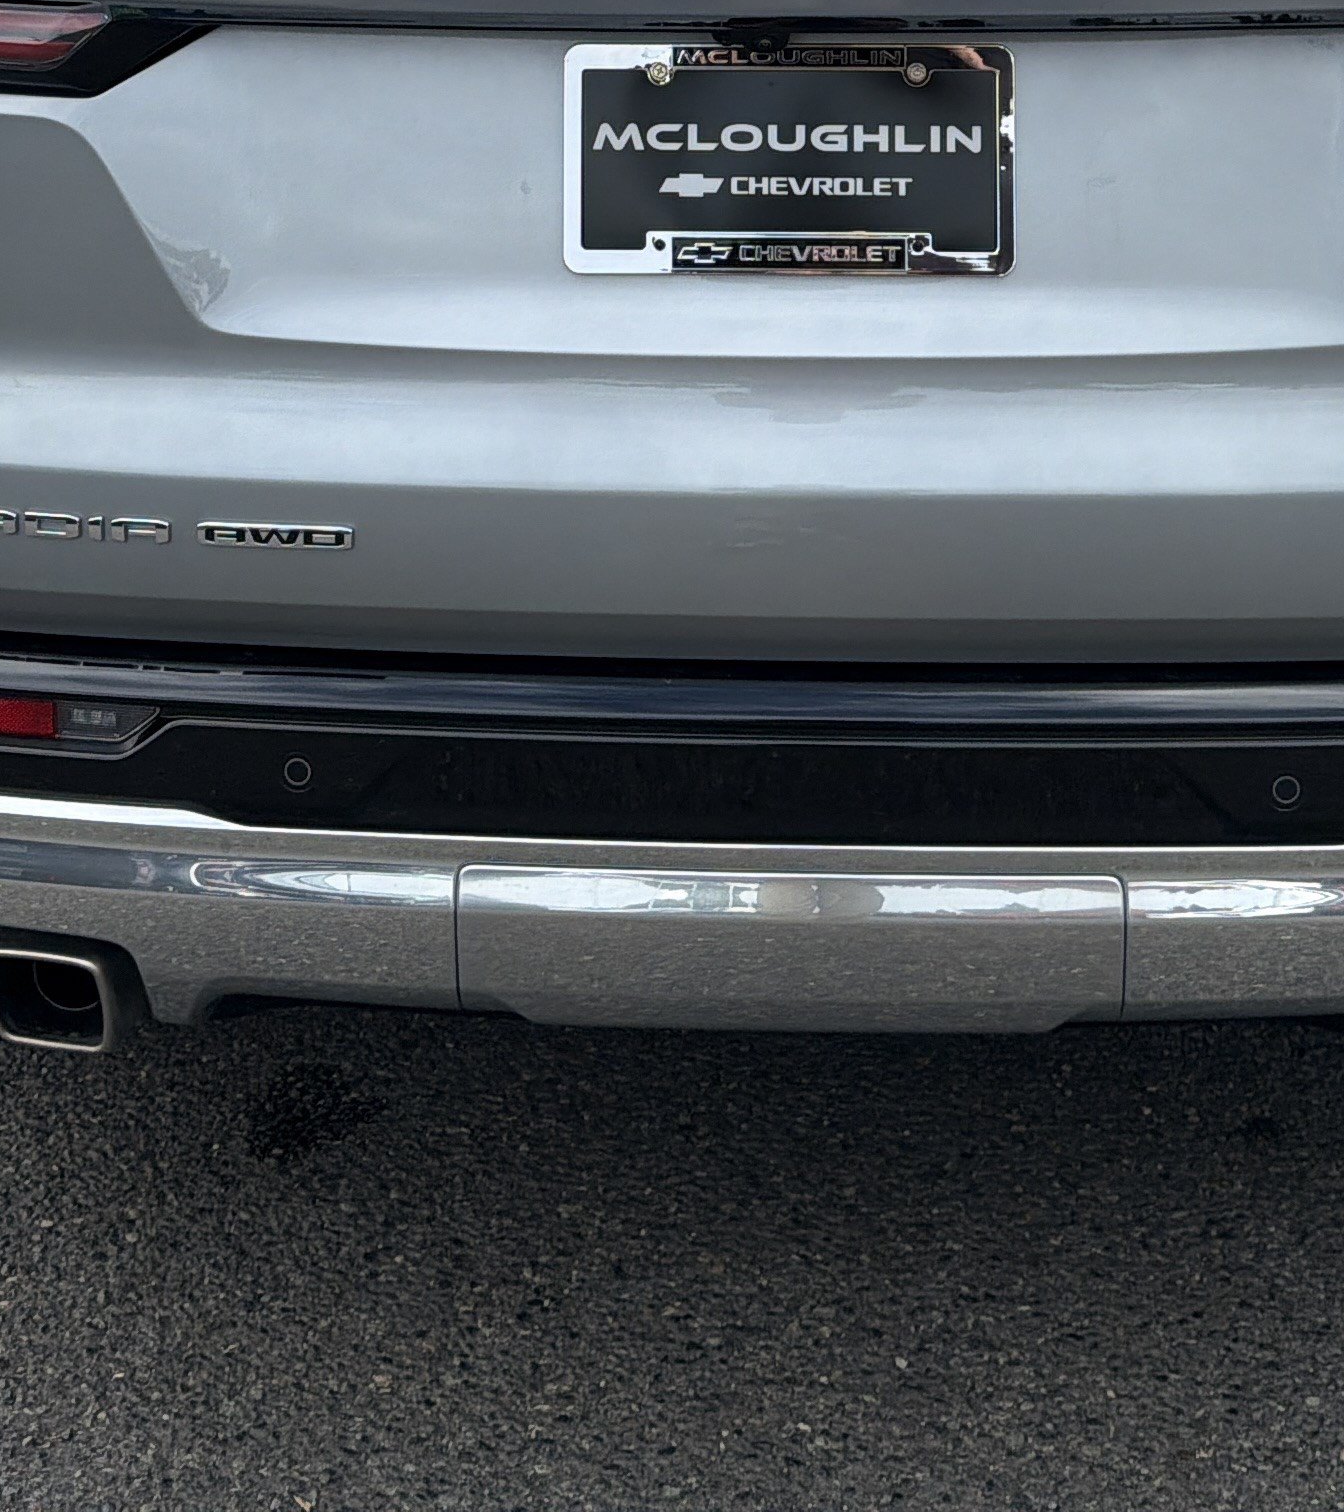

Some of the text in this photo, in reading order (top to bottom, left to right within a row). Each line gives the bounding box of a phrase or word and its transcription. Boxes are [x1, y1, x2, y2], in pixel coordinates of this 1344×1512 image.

[676, 49, 903, 67] MCLOUGHLIN
[593, 122, 983, 154] MCLOUGHLIN
[730, 175, 913, 197] CHEVROLET
[739, 244, 903, 263] CHEVROLET
[199, 521, 352, 550] AWD
